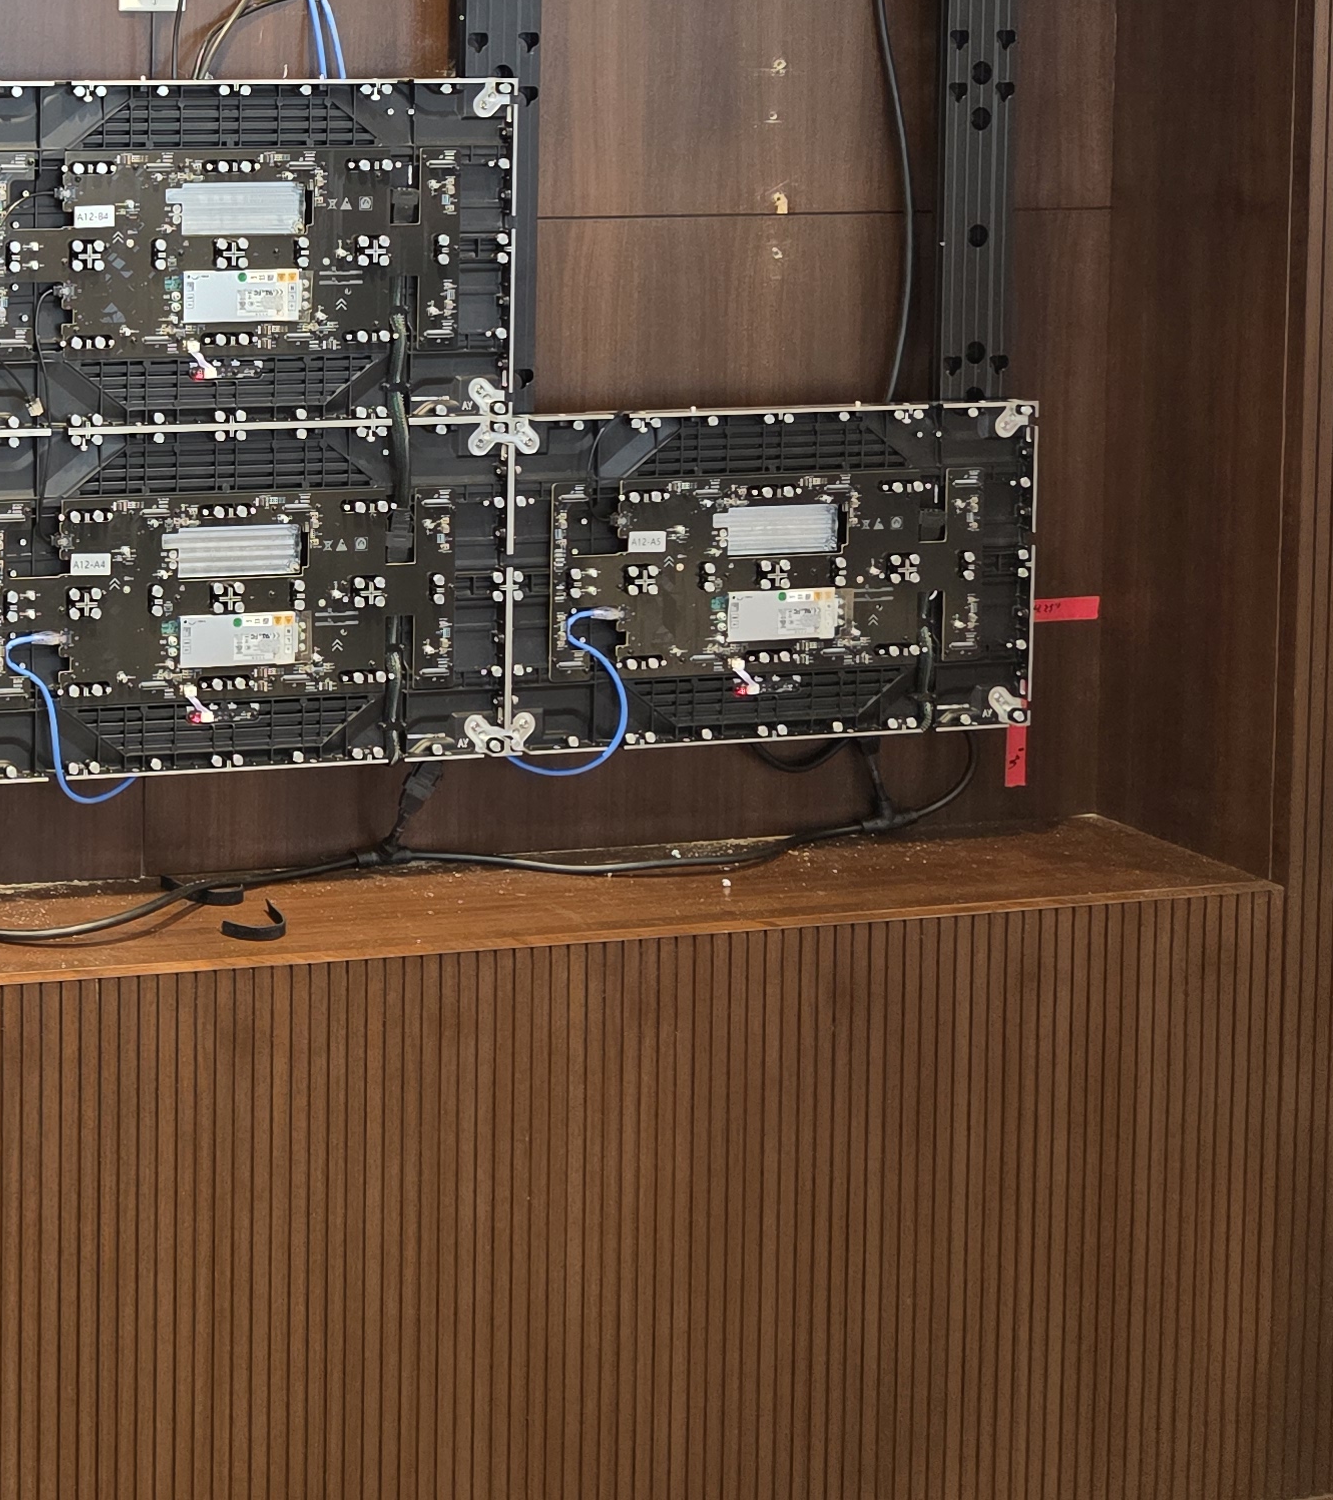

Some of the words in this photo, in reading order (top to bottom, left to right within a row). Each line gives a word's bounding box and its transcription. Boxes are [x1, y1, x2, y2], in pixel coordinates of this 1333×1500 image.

[76, 211, 110, 223] A12-B4
[461, 401, 474, 410] AY
[631, 537, 661, 547] A12-A5
[73, 559, 107, 570] A12-A4
[457, 738, 470, 747] AY
